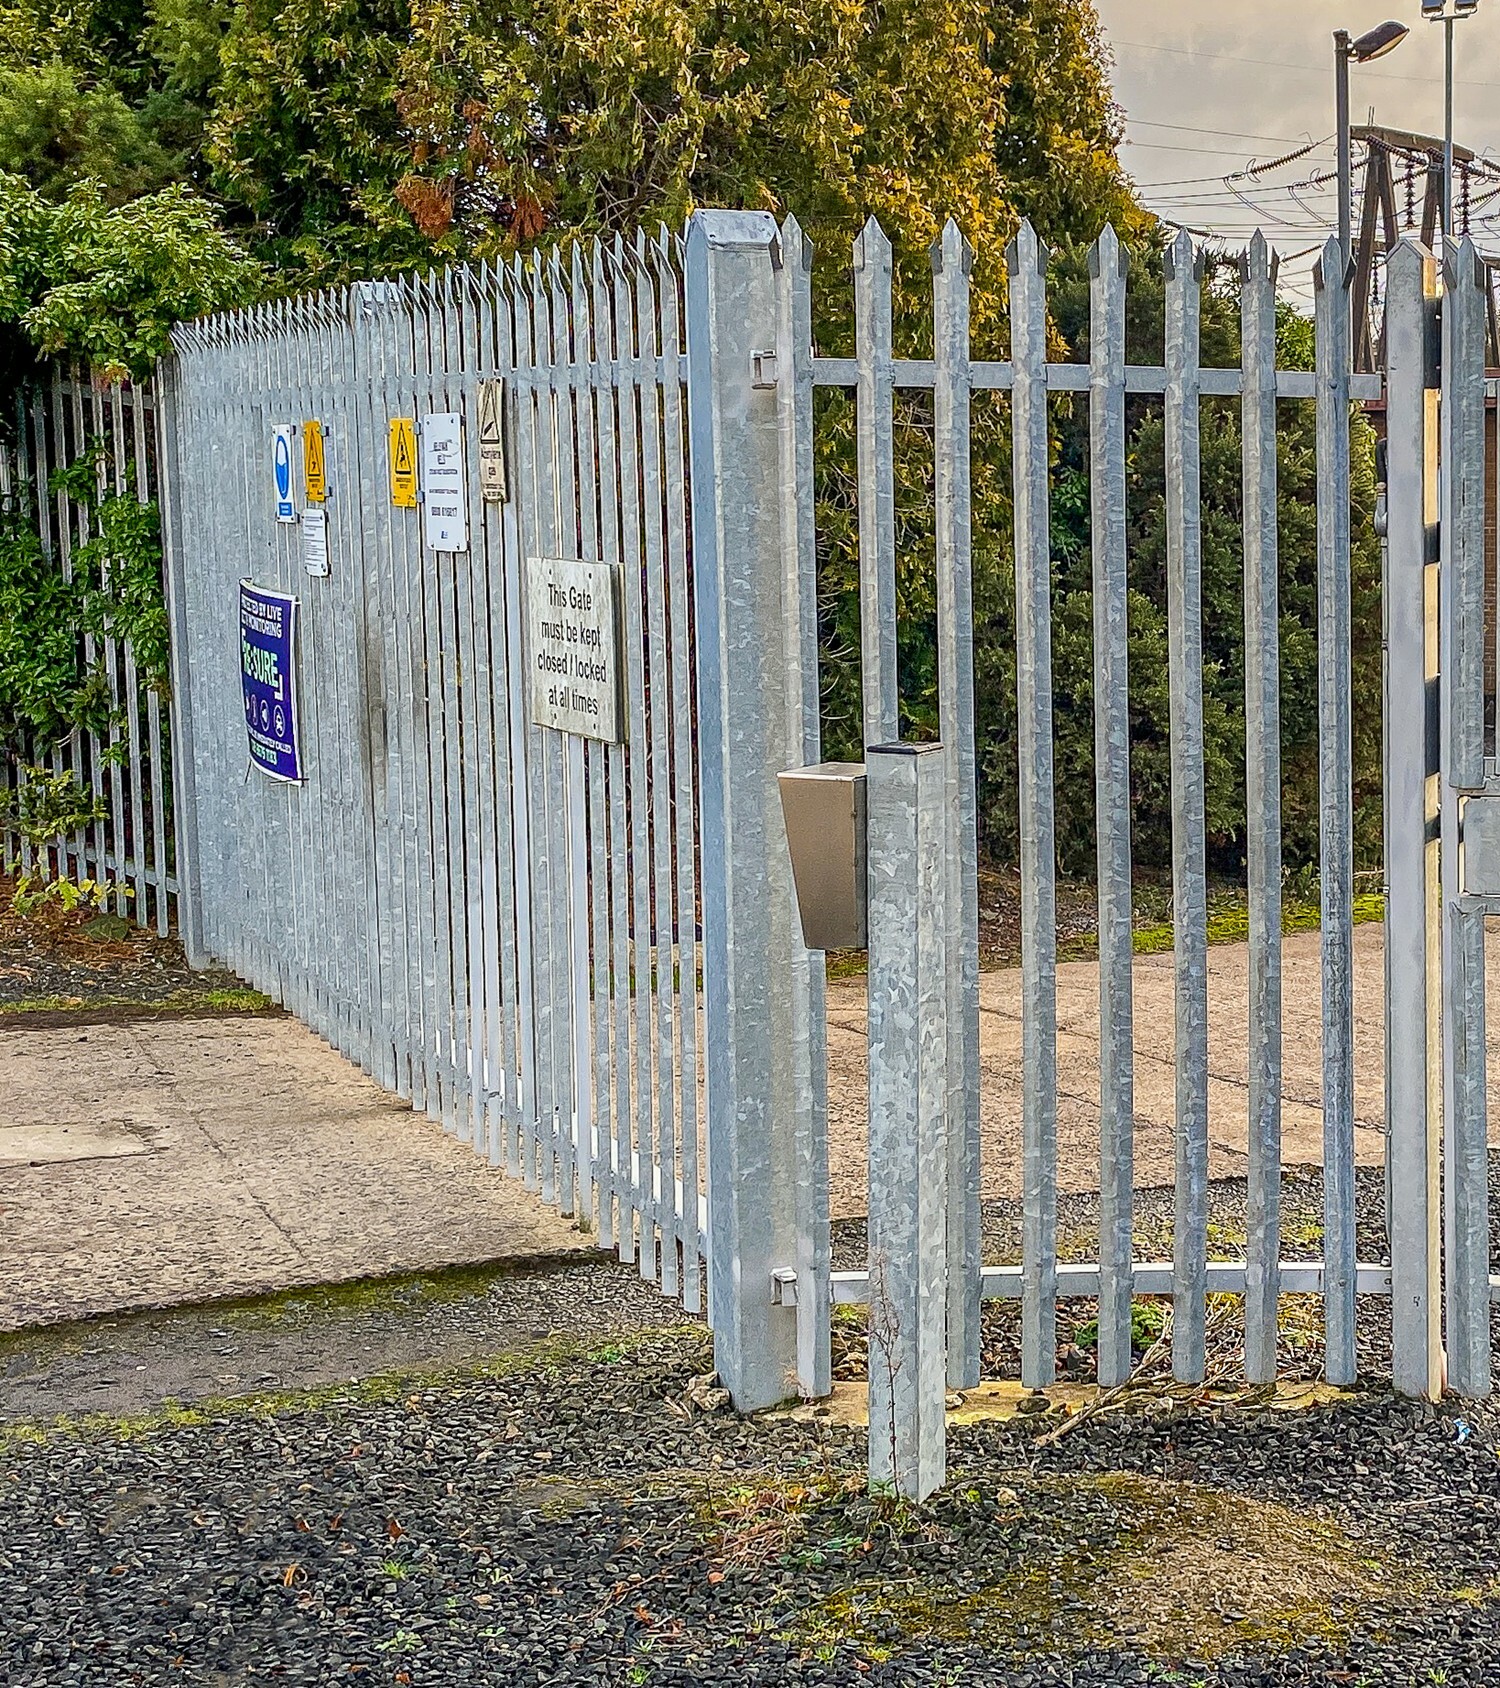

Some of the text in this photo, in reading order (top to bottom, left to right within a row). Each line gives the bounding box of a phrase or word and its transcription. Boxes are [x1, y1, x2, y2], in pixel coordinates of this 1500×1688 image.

[267, 604, 283, 622] LIVE
[548, 583, 592, 612] This Gate
[541, 619, 602, 652] must be kept
[537, 649, 607, 683] closed / locked
[549, 685, 599, 716] at all times
